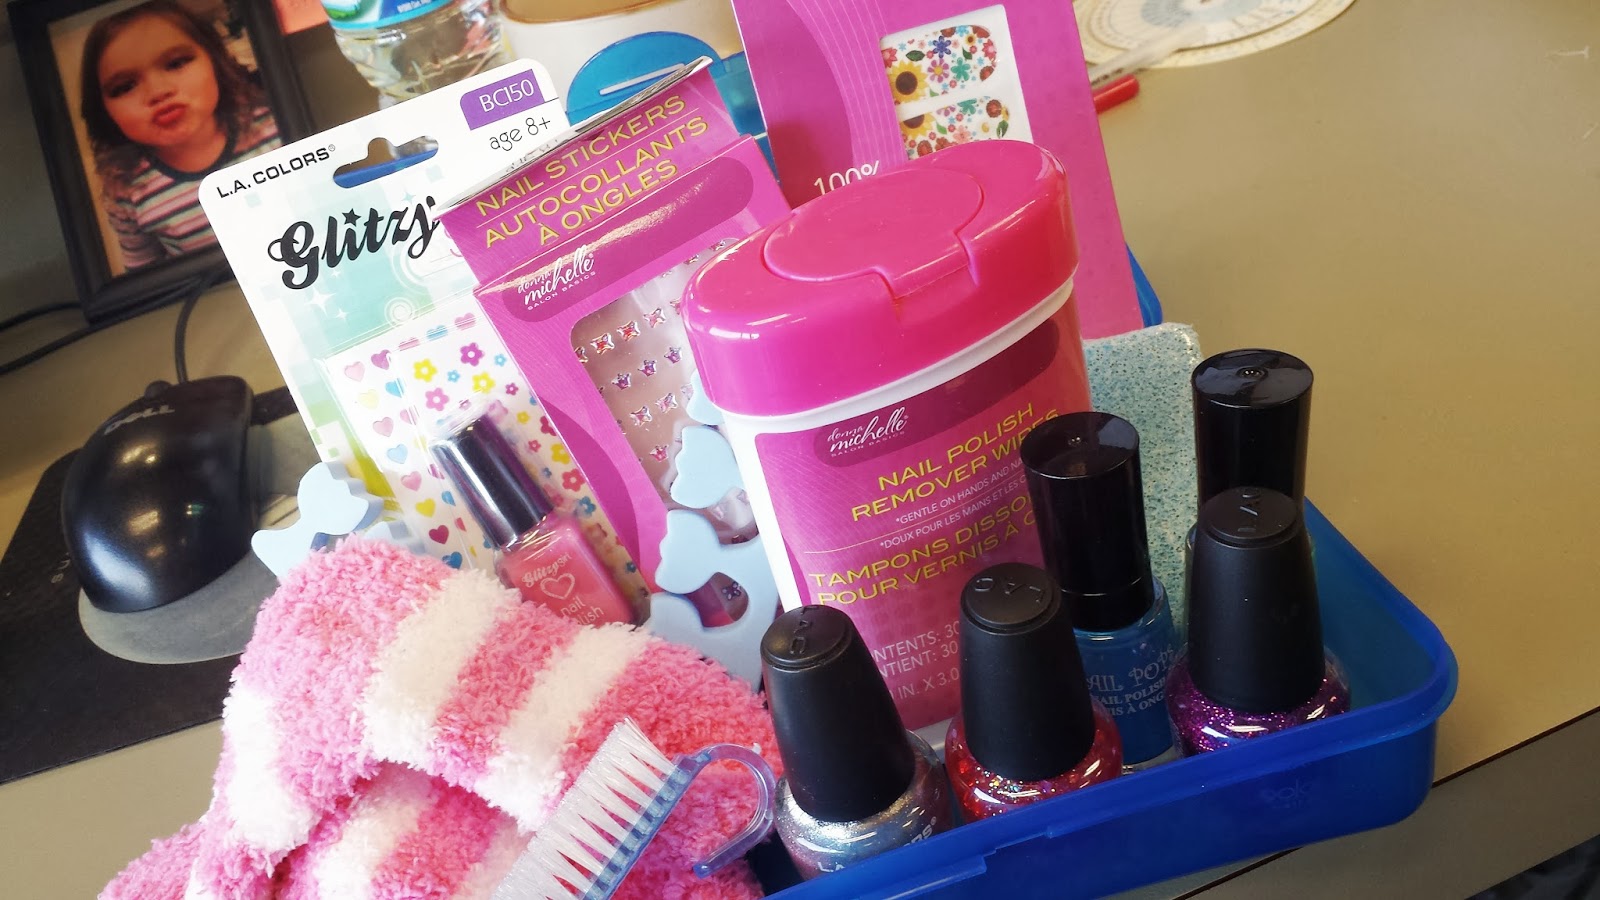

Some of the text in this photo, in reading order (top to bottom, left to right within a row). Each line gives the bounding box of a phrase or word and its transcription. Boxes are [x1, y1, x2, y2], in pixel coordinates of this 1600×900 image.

[476, 171, 545, 217] NAIL
[545, 95, 687, 180] STICKERS
[489, 117, 551, 152] age 8+
[216, 147, 330, 199] L.A. COLORS
[486, 115, 709, 249] AUTOCOLLANTS
[539, 159, 679, 246] À ONGLES
[267, 195, 440, 290] Glitzy
[524, 244, 594, 306] michelle
[527, 292, 558, 311] SALON
[830, 407, 908, 452] michelle
[878, 402, 1034, 491] NAIL POLISH
[851, 408, 1060, 522] REMOVER WIPS
[940, 496, 956, 508] ON
[957, 478, 990, 501] HANDS
[991, 466, 1009, 482] AND
[916, 519, 943, 538] POUR
[945, 513, 961, 527] LES
[962, 496, 992, 519] MAINS
[1003, 481, 1019, 496] LES
[808, 492, 1034, 588] TAMPONS DISSO
[818, 520, 1019, 606] POUR VERNIS À
[560, 595, 587, 616] nail
[576, 605, 605, 626] lish
[870, 630, 942, 664] NTENTS:
[879, 650, 937, 679] NTIENT:
[924, 676, 935, 692] X
[1086, 674, 1124, 692] AIL
